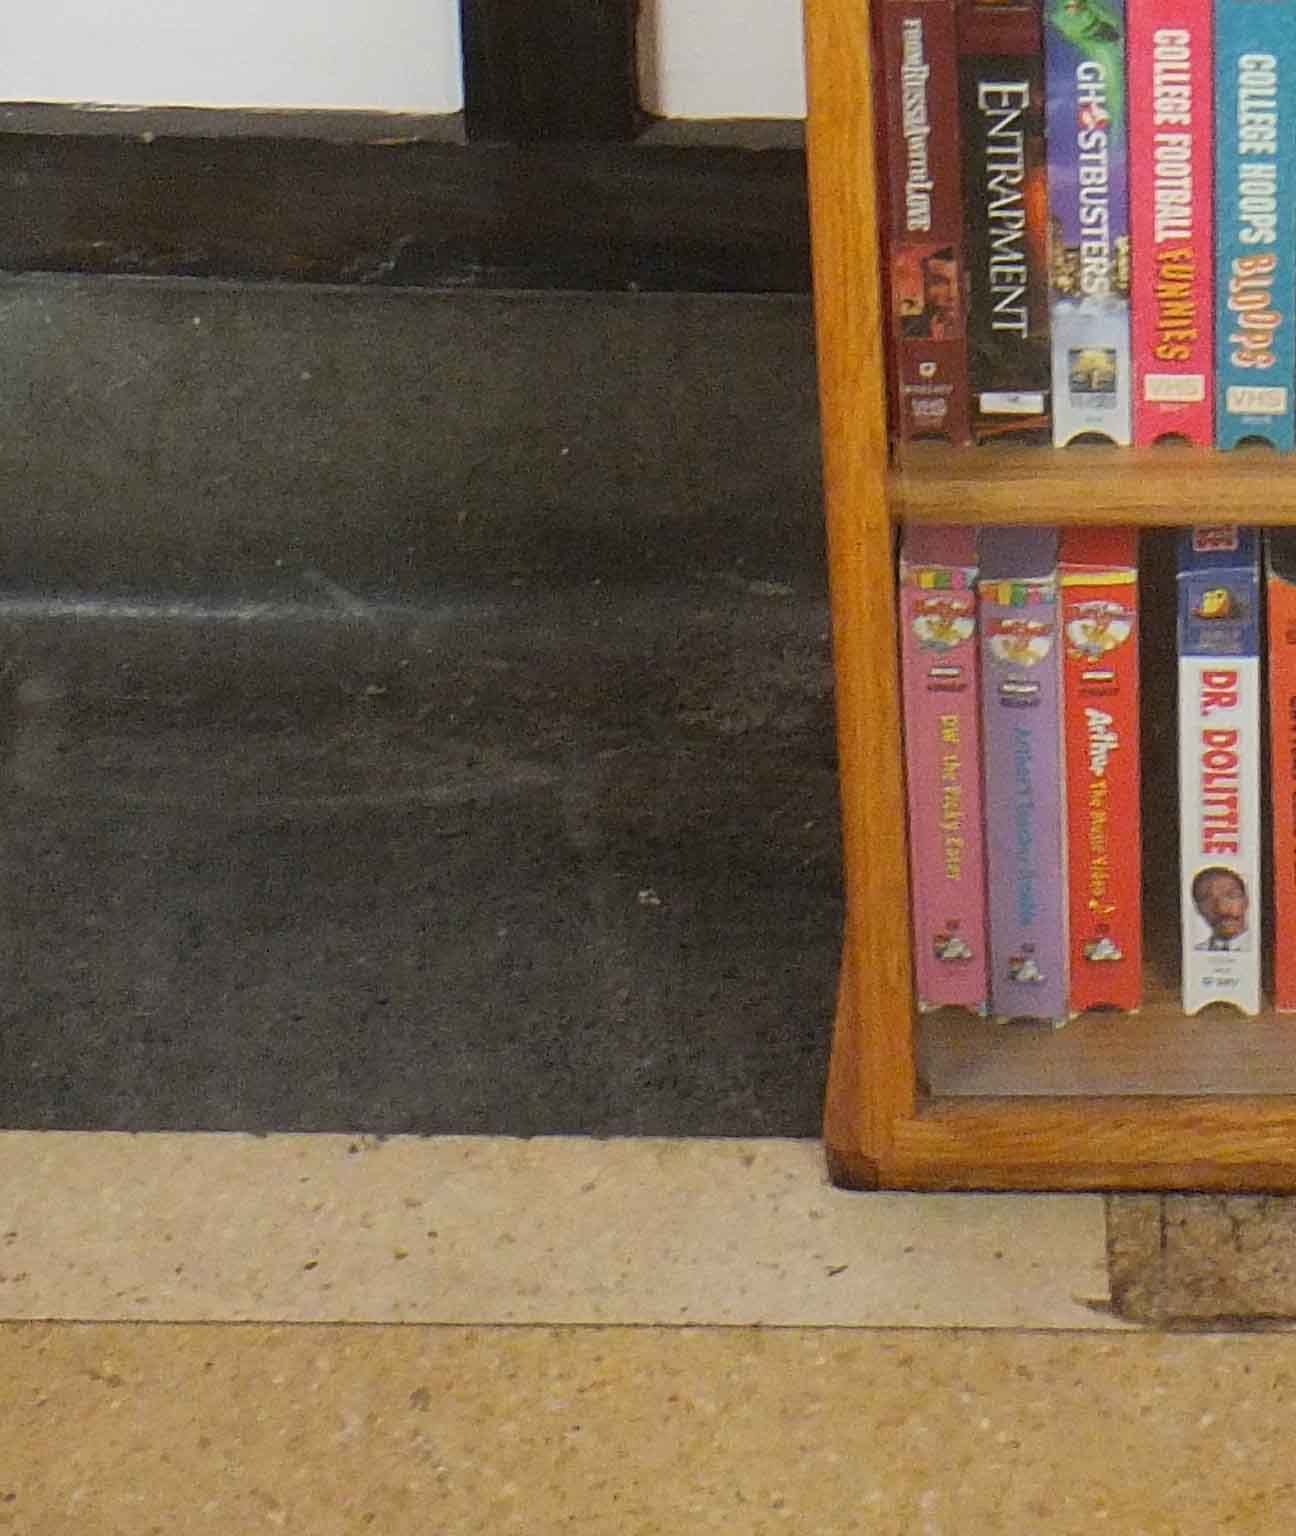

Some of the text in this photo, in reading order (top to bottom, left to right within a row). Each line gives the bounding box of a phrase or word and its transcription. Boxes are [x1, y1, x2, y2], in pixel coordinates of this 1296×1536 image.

[977, 79, 1030, 340] ENTRAPMENT
[1152, 28, 1198, 362] COLLEGE FOOTBALL FUNNIES
[1226, 53, 1283, 369] COLLEGE HOOPS BLOOPS
[1199, 670, 1240, 857] DR. DOLITTLE
